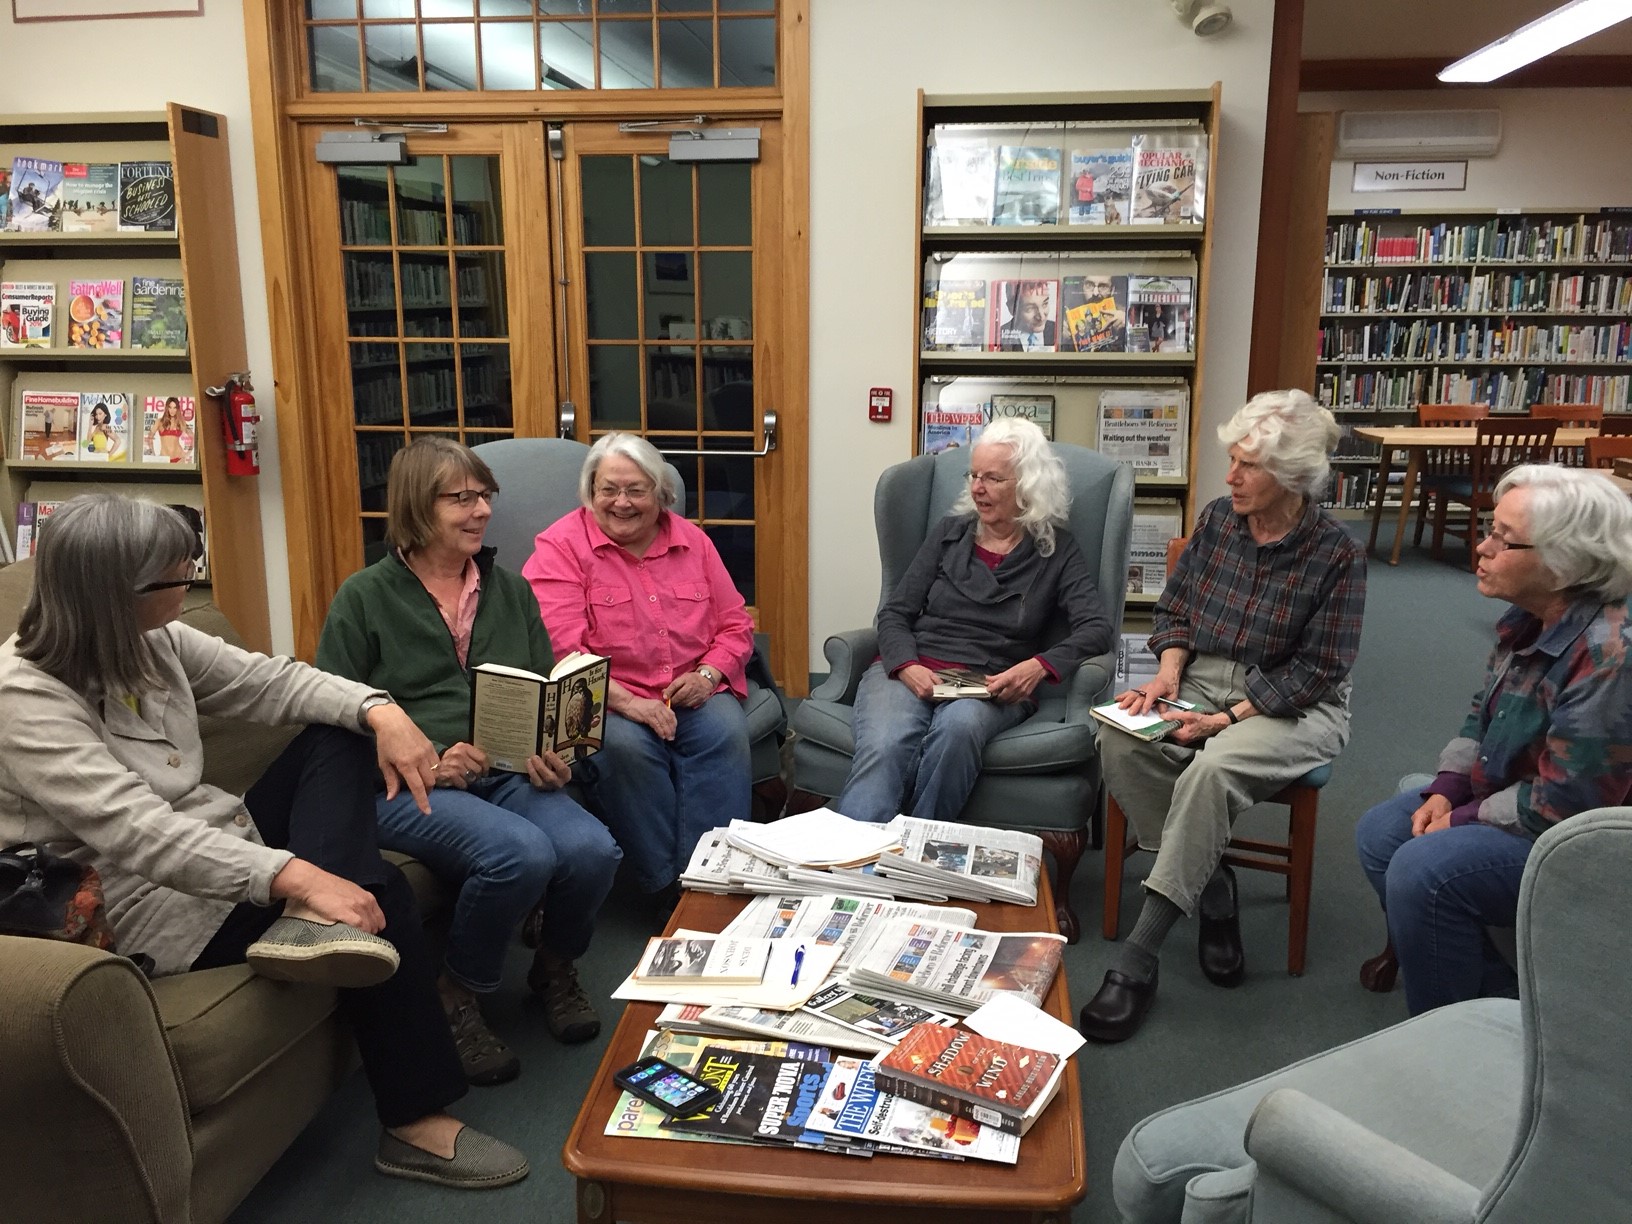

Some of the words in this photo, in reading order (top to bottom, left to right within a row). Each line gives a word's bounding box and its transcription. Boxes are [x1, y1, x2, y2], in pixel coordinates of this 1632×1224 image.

[1374, 170, 1445, 181] Non-Fiction
[123, 193, 169, 218] SCHOOLED
[1, 293, 54, 302] ConsumerReports
[133, 283, 185, 298] Gardening
[22, 307, 50, 317] Buying
[26, 314, 49, 322] Guide
[144, 396, 195, 412] Heth
[994, 404, 1039, 418] yoga
[928, 413, 951, 424] THE
[951, 413, 982, 424] WEEK
[1102, 434, 1125, 442] Waiting
[562, 678, 572, 695] H
[587, 673, 607, 686] Hawk
[546, 692, 556, 703] H
[958, 947, 977, 965] facing
[927, 1031, 972, 1078] SHADOW
[975, 1054, 1009, 1089] WIND
[786, 1073, 821, 1128] Sports
[758, 1095, 791, 1136] SUPER
[836, 1099, 870, 1132] THE
